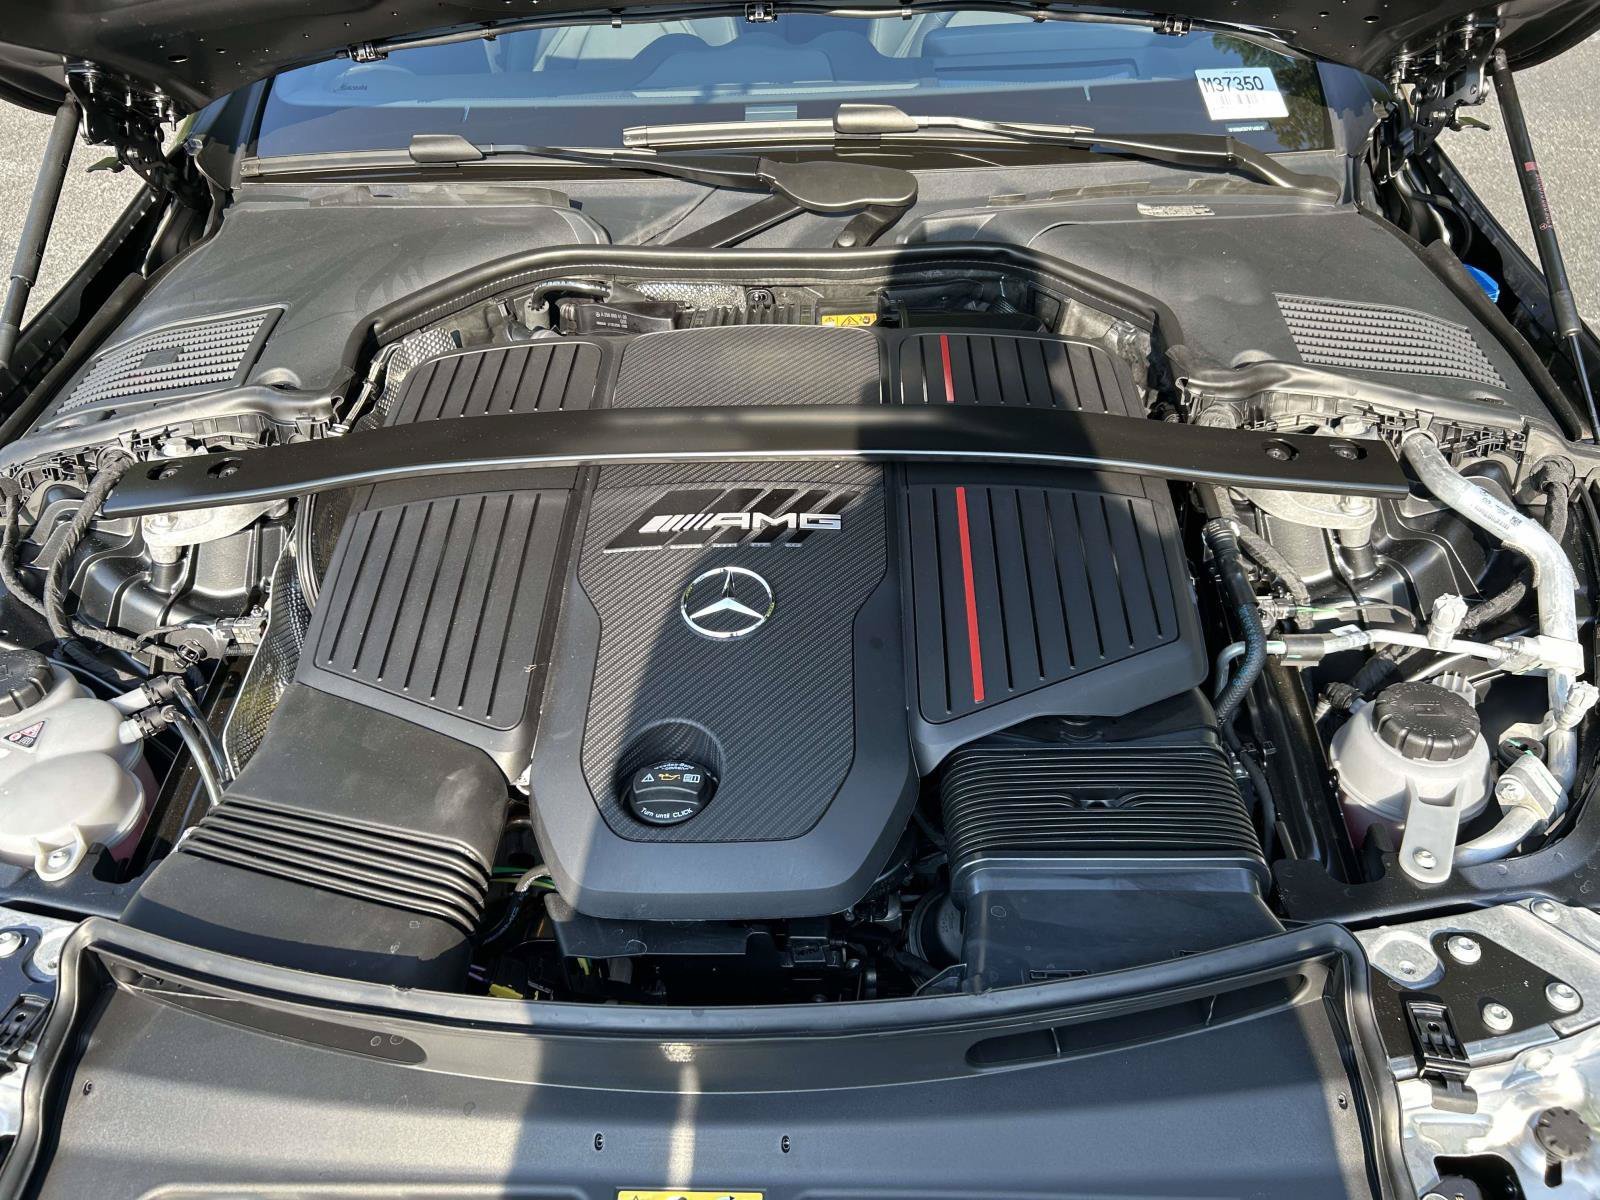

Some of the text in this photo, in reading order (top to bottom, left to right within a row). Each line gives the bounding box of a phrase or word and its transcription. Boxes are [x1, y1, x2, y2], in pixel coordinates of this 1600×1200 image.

[1201, 75, 1264, 92] M37350
[702, 512, 842, 530] AMG
[640, 807, 654, 817] Turn
[672, 808, 694, 818] CLICK
